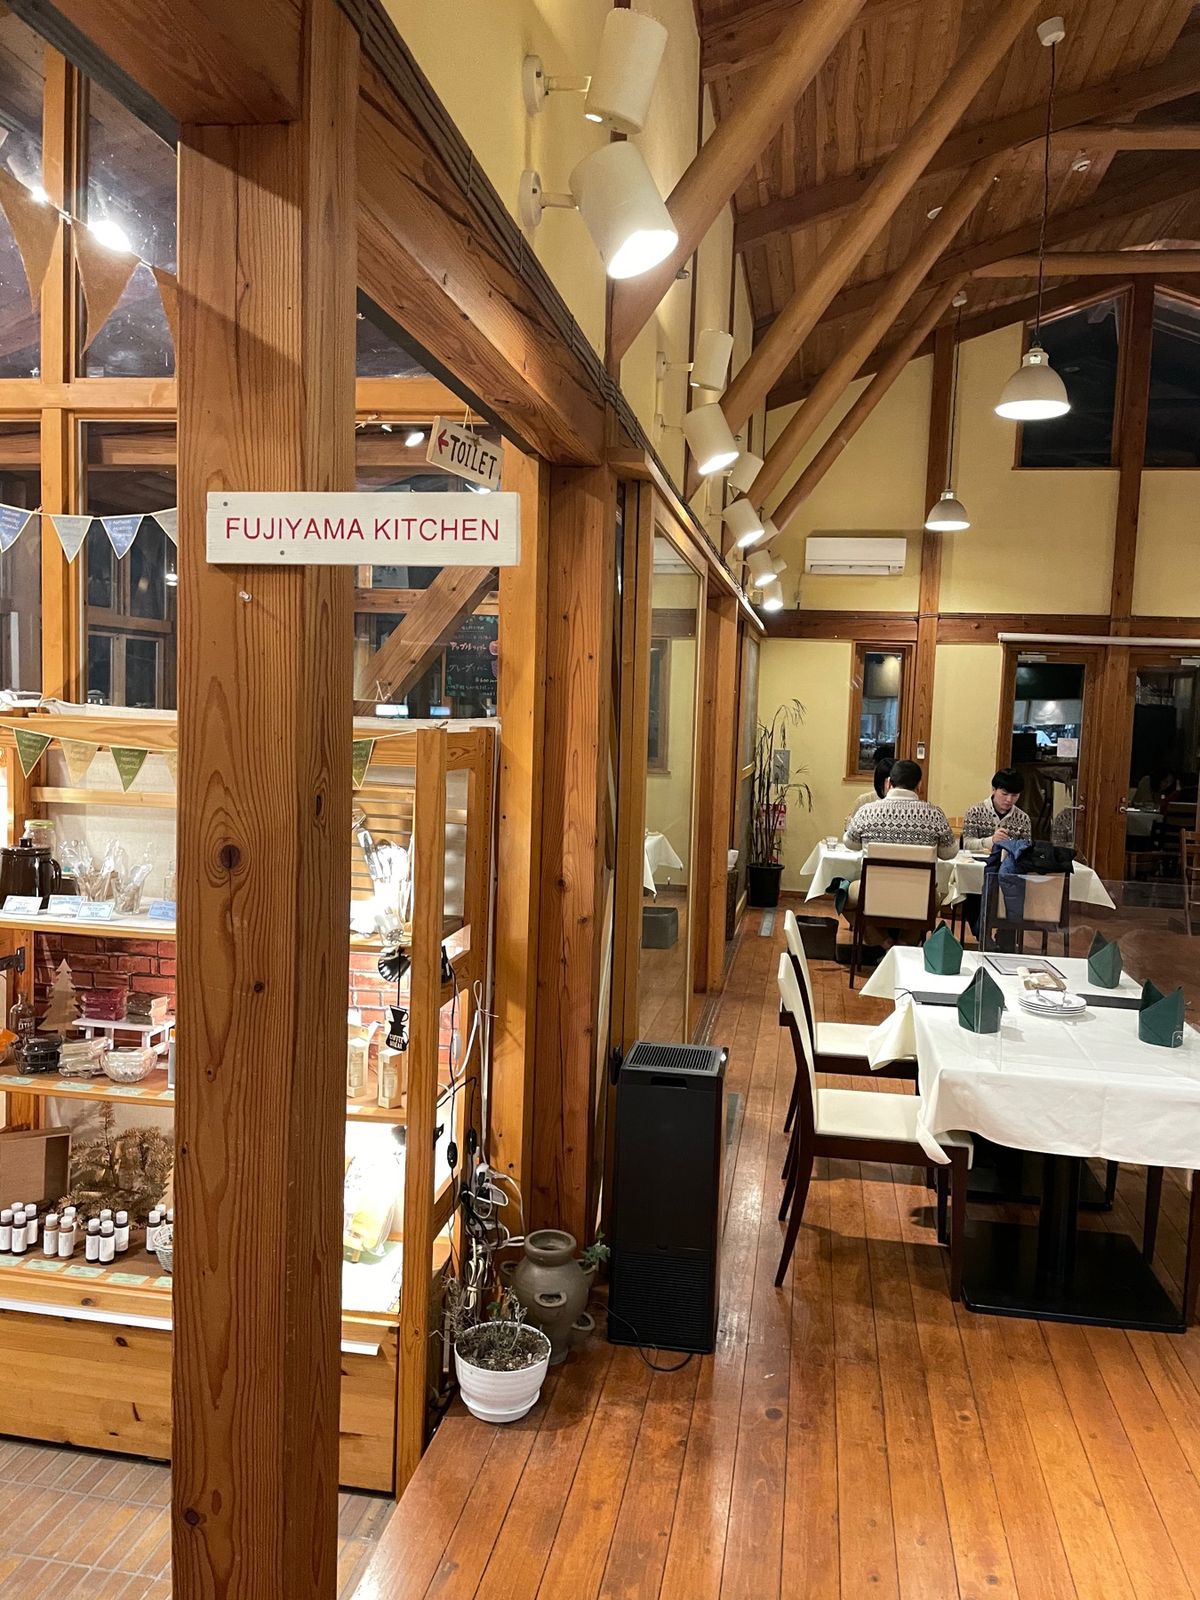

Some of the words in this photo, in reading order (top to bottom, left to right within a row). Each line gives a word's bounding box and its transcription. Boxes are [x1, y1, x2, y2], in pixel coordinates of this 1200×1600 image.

[450, 434, 497, 479] TOILET
[226, 517, 364, 541] FUJIYAMA
[374, 517, 499, 542] KITCHEN
